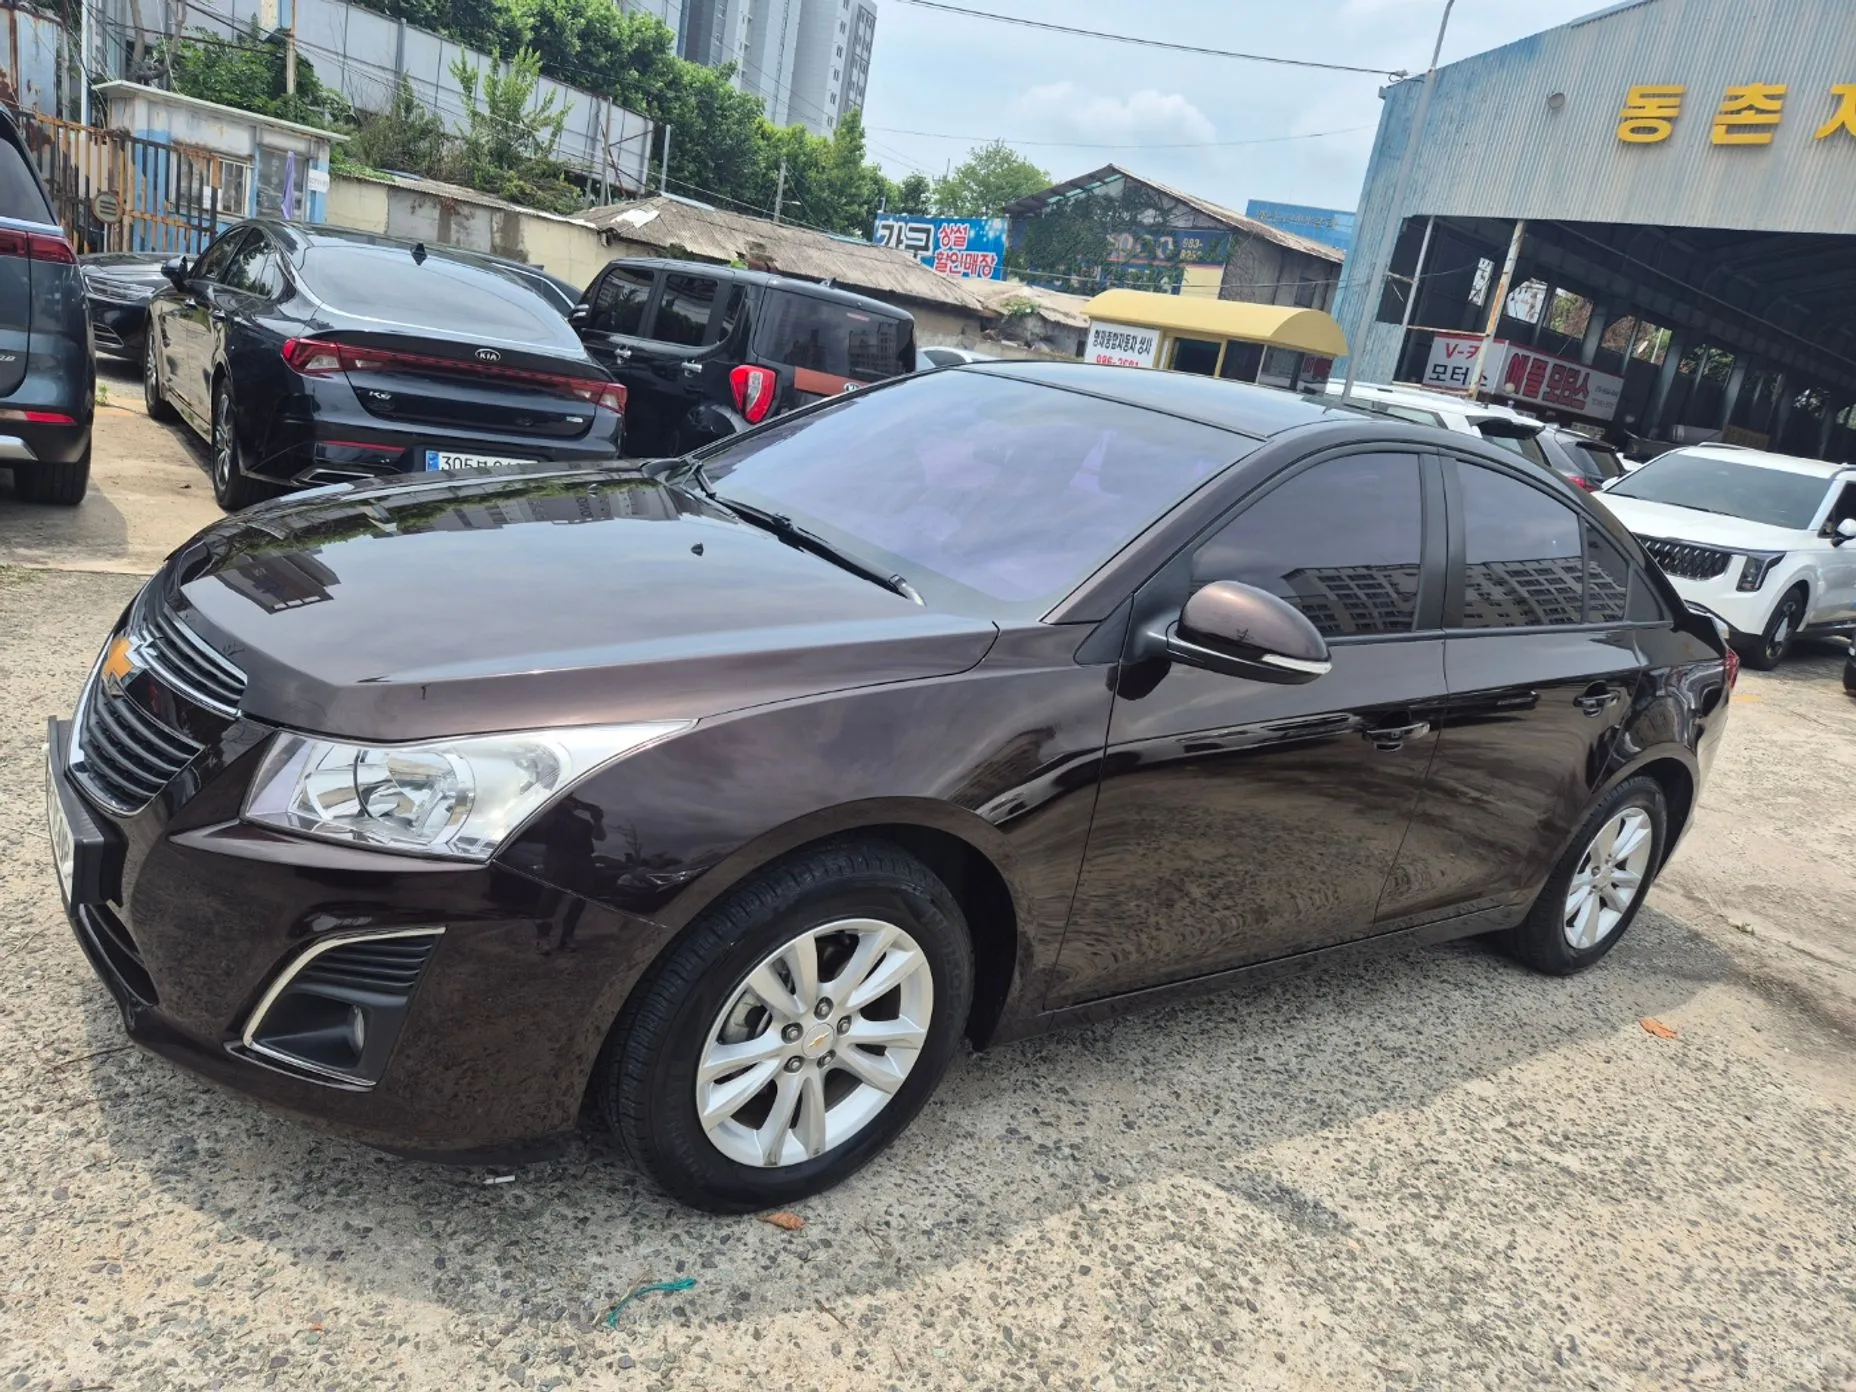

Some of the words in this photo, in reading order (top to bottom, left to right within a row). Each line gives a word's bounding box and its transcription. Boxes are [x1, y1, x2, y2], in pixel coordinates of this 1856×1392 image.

[937, 222, 970, 249] 상설
[933, 251, 997, 278] 할인매장
[478, 350, 498, 361] KIA
